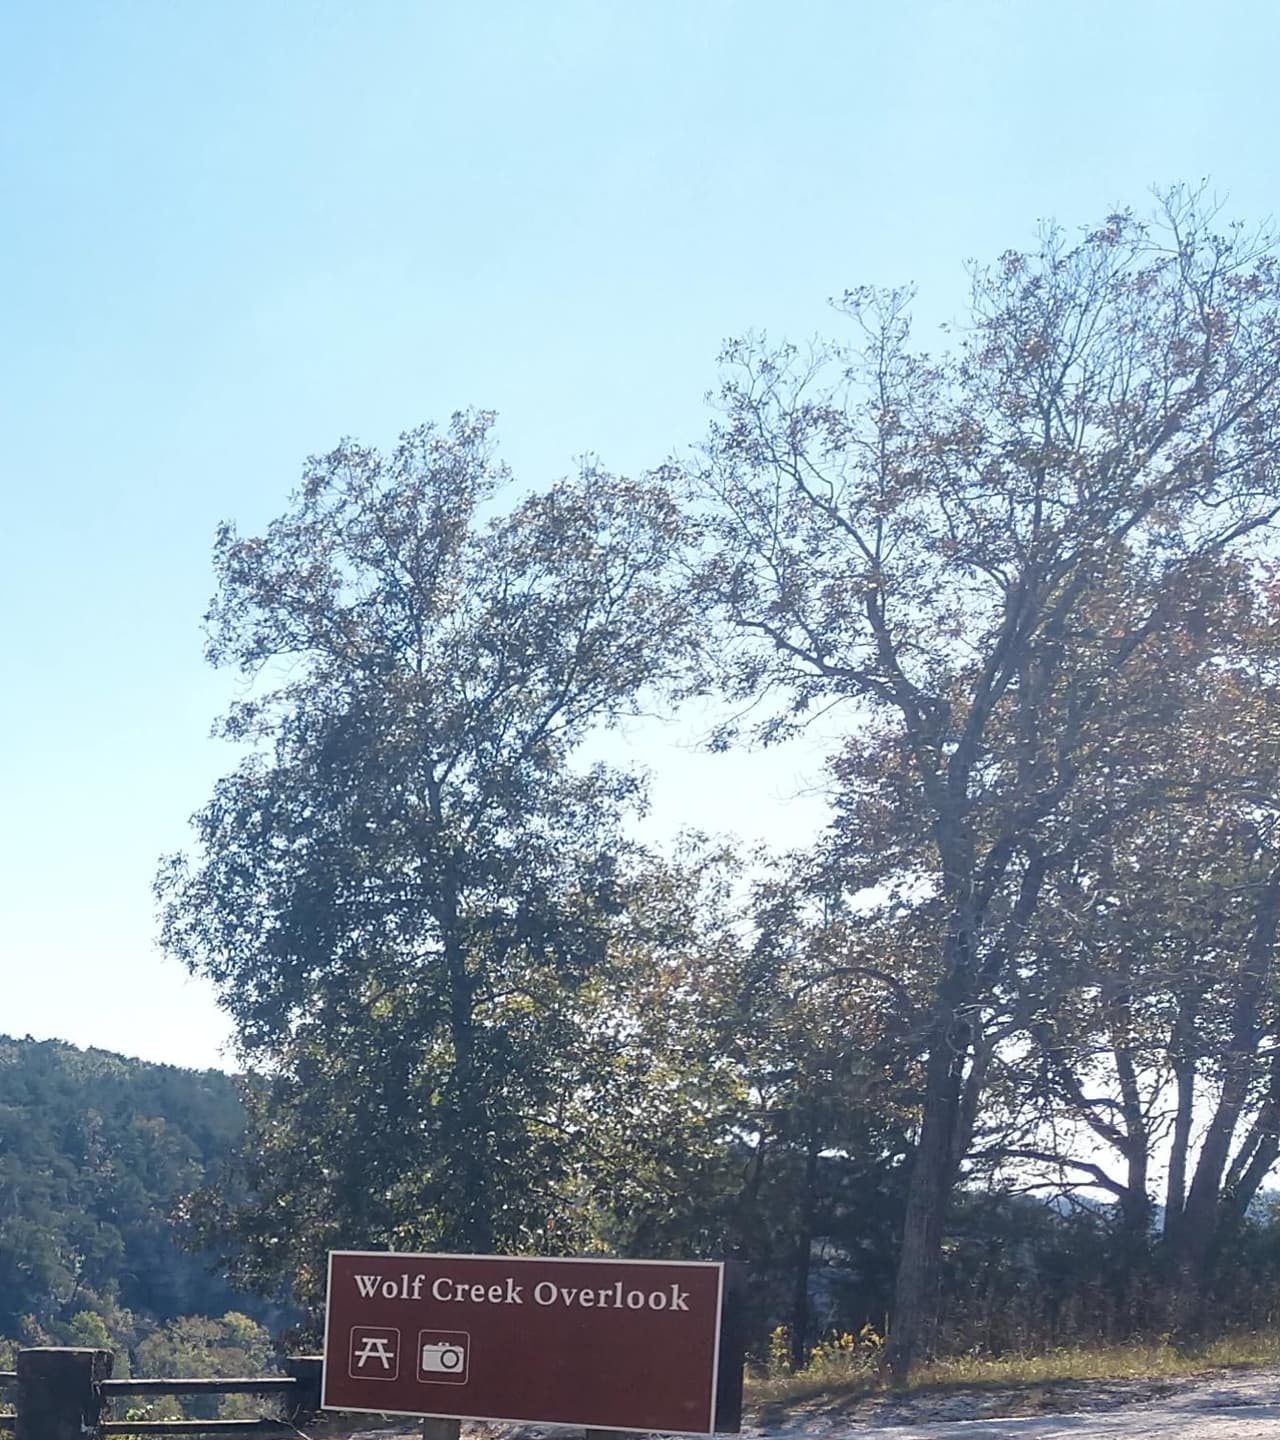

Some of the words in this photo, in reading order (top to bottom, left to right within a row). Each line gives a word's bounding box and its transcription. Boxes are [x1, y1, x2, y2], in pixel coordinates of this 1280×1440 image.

[353, 1274, 426, 1300] Wolf
[431, 1277, 524, 1305] Creek
[533, 1281, 690, 1311] Overlook
